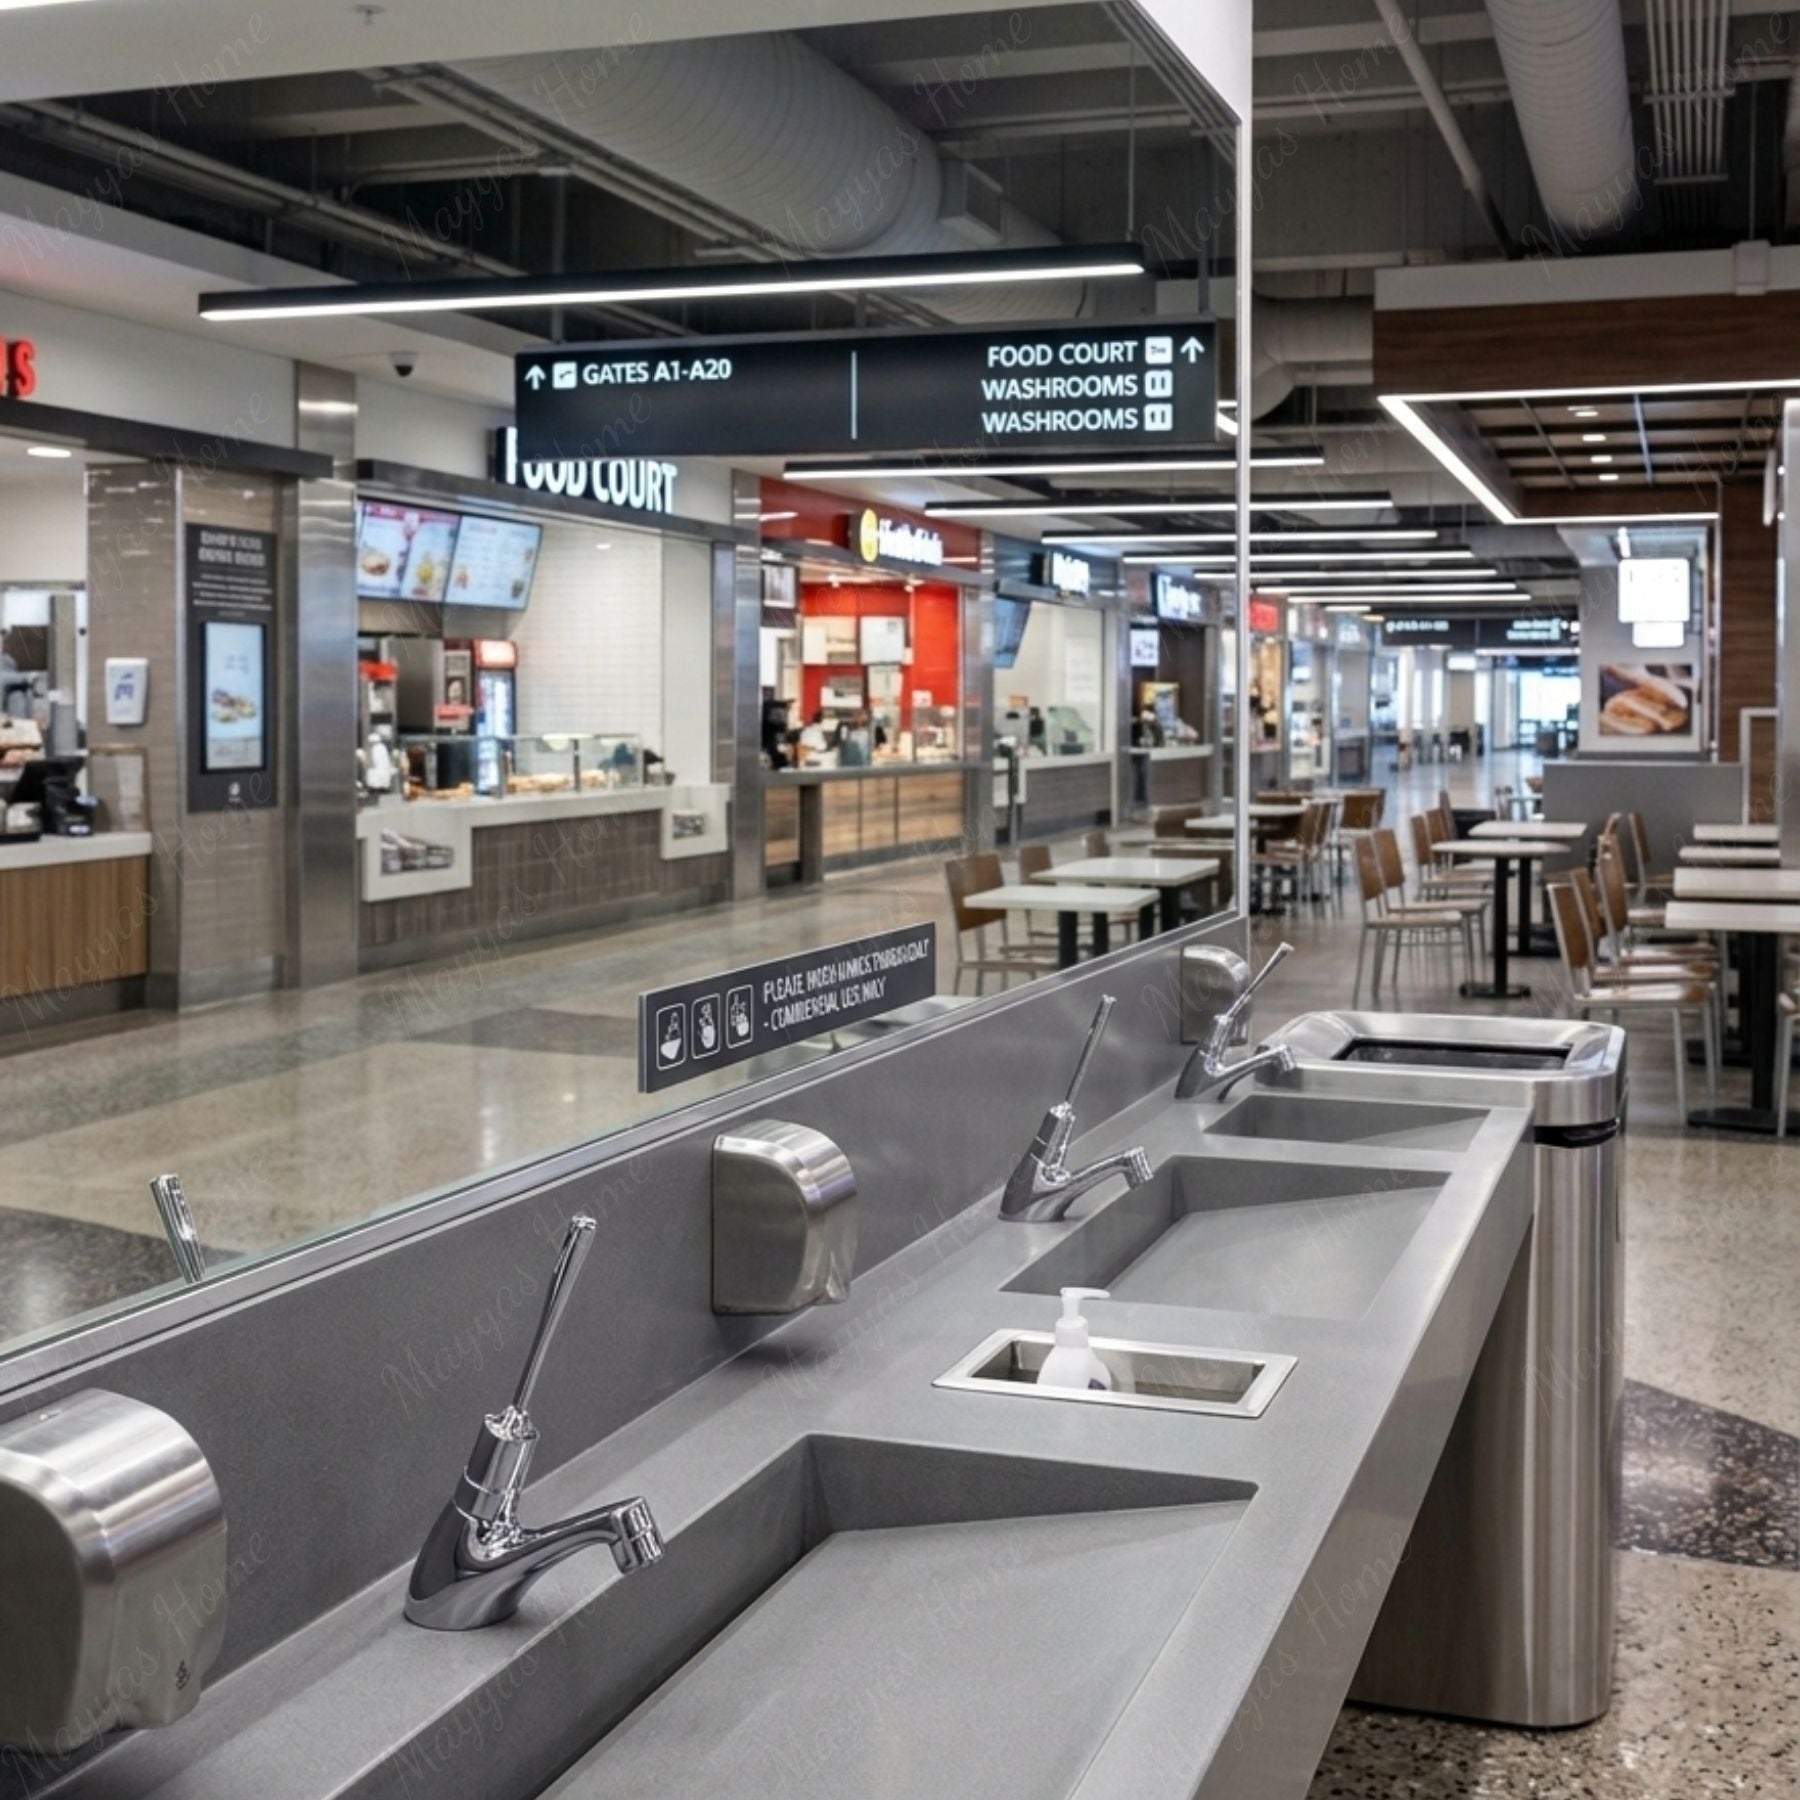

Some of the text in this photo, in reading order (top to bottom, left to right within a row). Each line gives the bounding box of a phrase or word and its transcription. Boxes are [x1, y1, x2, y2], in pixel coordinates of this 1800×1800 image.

[987, 340, 1138, 368] FOOD COURT
[582, 357, 733, 386] GATES A1-A20
[981, 373, 1138, 401] WASHROOMS
[981, 407, 1138, 434] WASHROOMS
[592, 458, 678, 514] COURT
